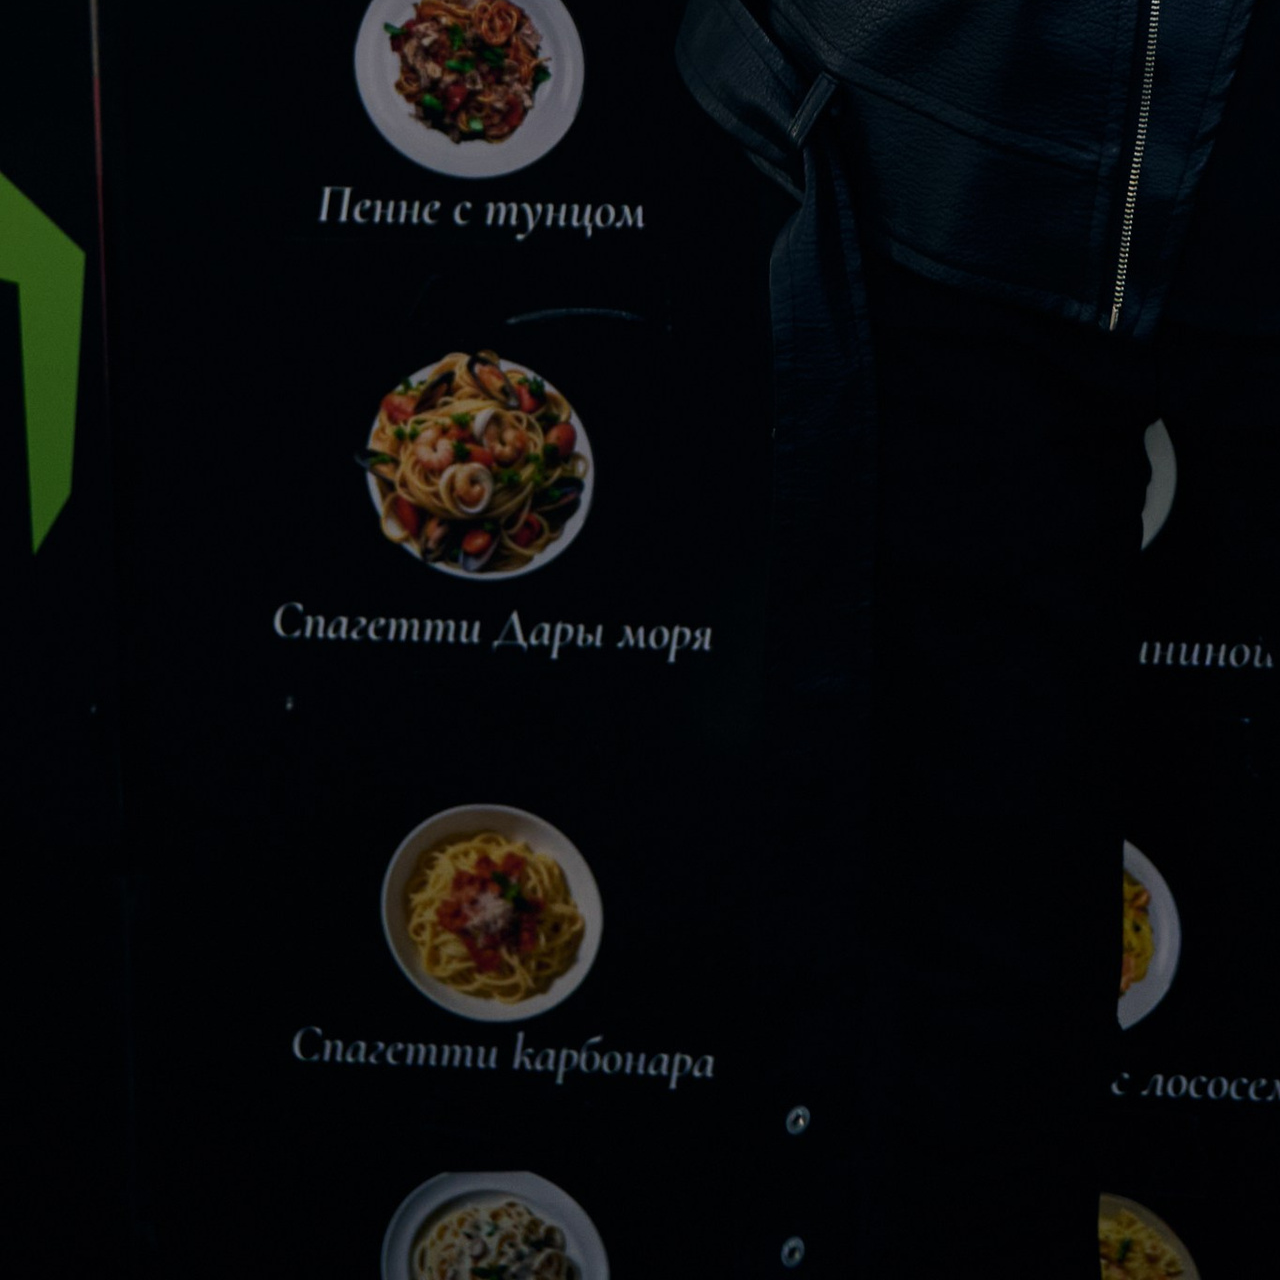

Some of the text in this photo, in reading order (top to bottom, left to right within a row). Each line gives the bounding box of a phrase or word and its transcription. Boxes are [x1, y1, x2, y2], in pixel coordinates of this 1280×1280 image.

[317, 184, 646, 242] Пенне с тунцом
[272, 601, 713, 663] Спагетти Дары моря
[291, 1026, 716, 1089] Спагетти карбонара
